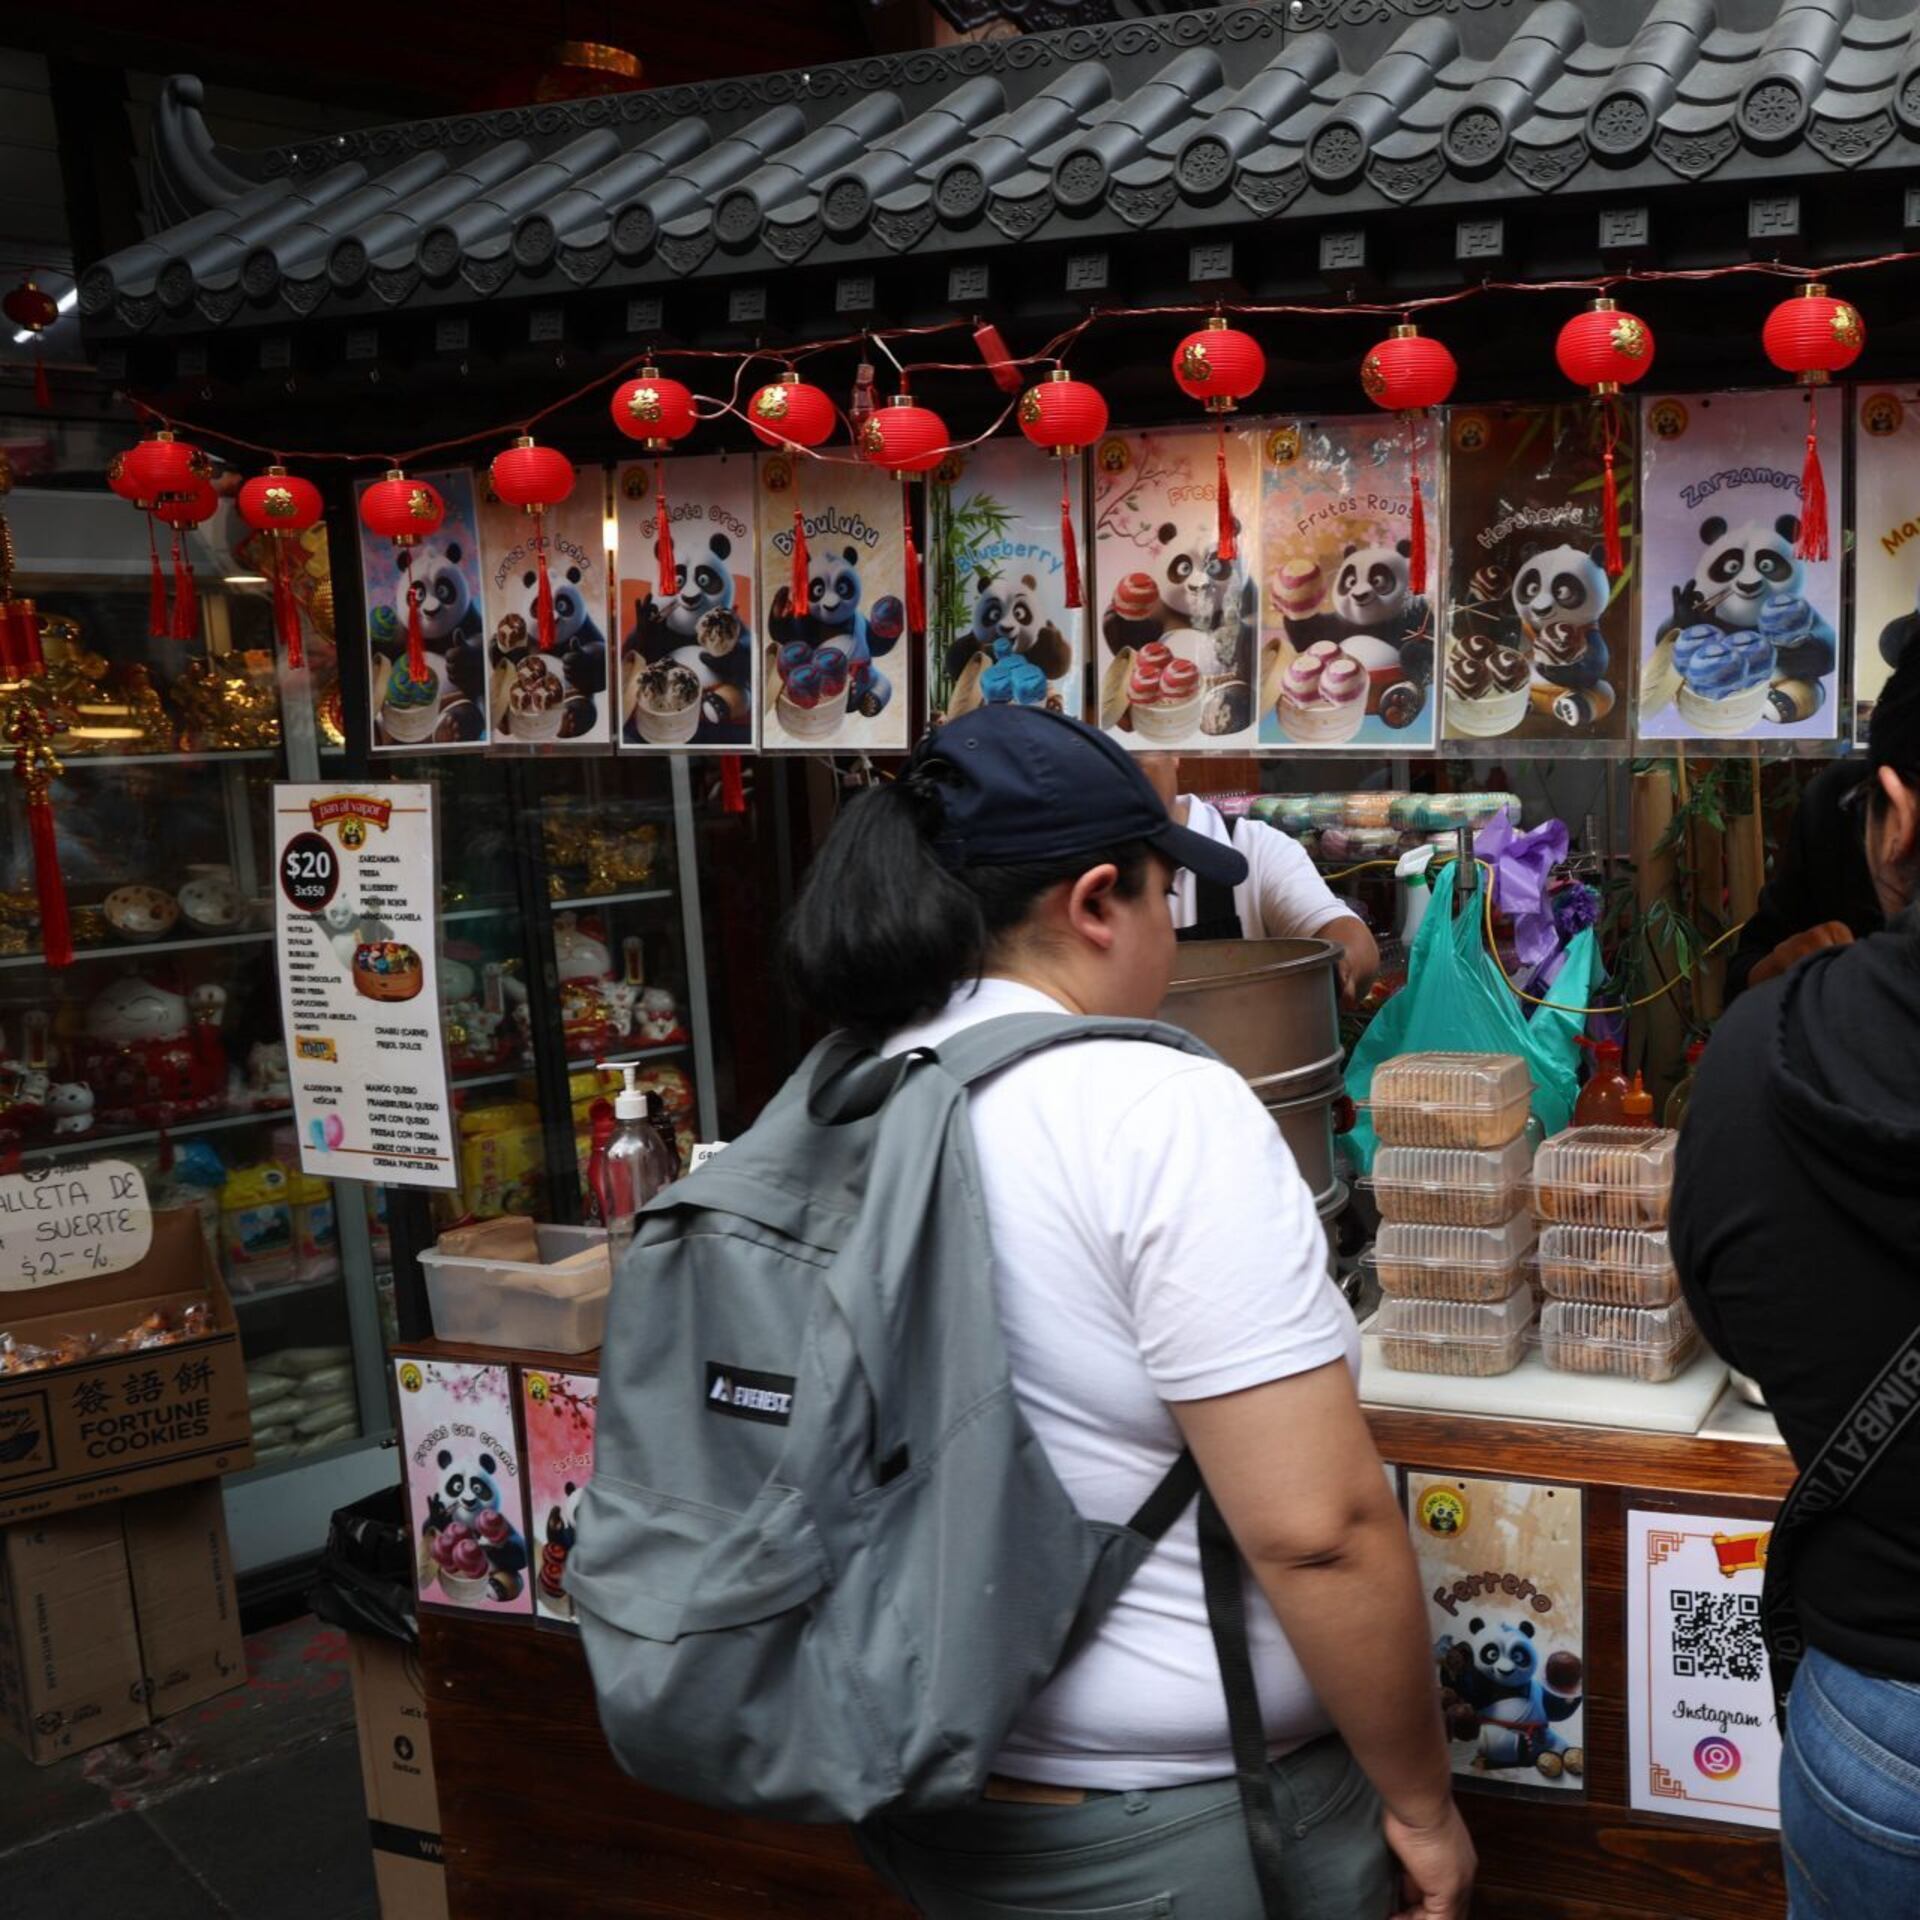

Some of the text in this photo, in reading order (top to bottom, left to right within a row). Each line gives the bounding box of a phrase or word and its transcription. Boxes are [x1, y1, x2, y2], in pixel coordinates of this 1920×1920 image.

[709, 504, 746, 538] Oreo
[1296, 498, 1357, 536] Frutos
[956, 537, 1063, 575] Blueberry
[286, 850, 331, 879] $20
[108, 1172, 140, 1200] DE
[36, 1208, 137, 1243] SUERTE
[80, 1398, 210, 1441] FORTUNE
[87, 1418, 210, 1459] COOKIES
[1433, 1570, 1553, 1617] Ferrero
[1671, 1700, 1762, 1733] Instagram
